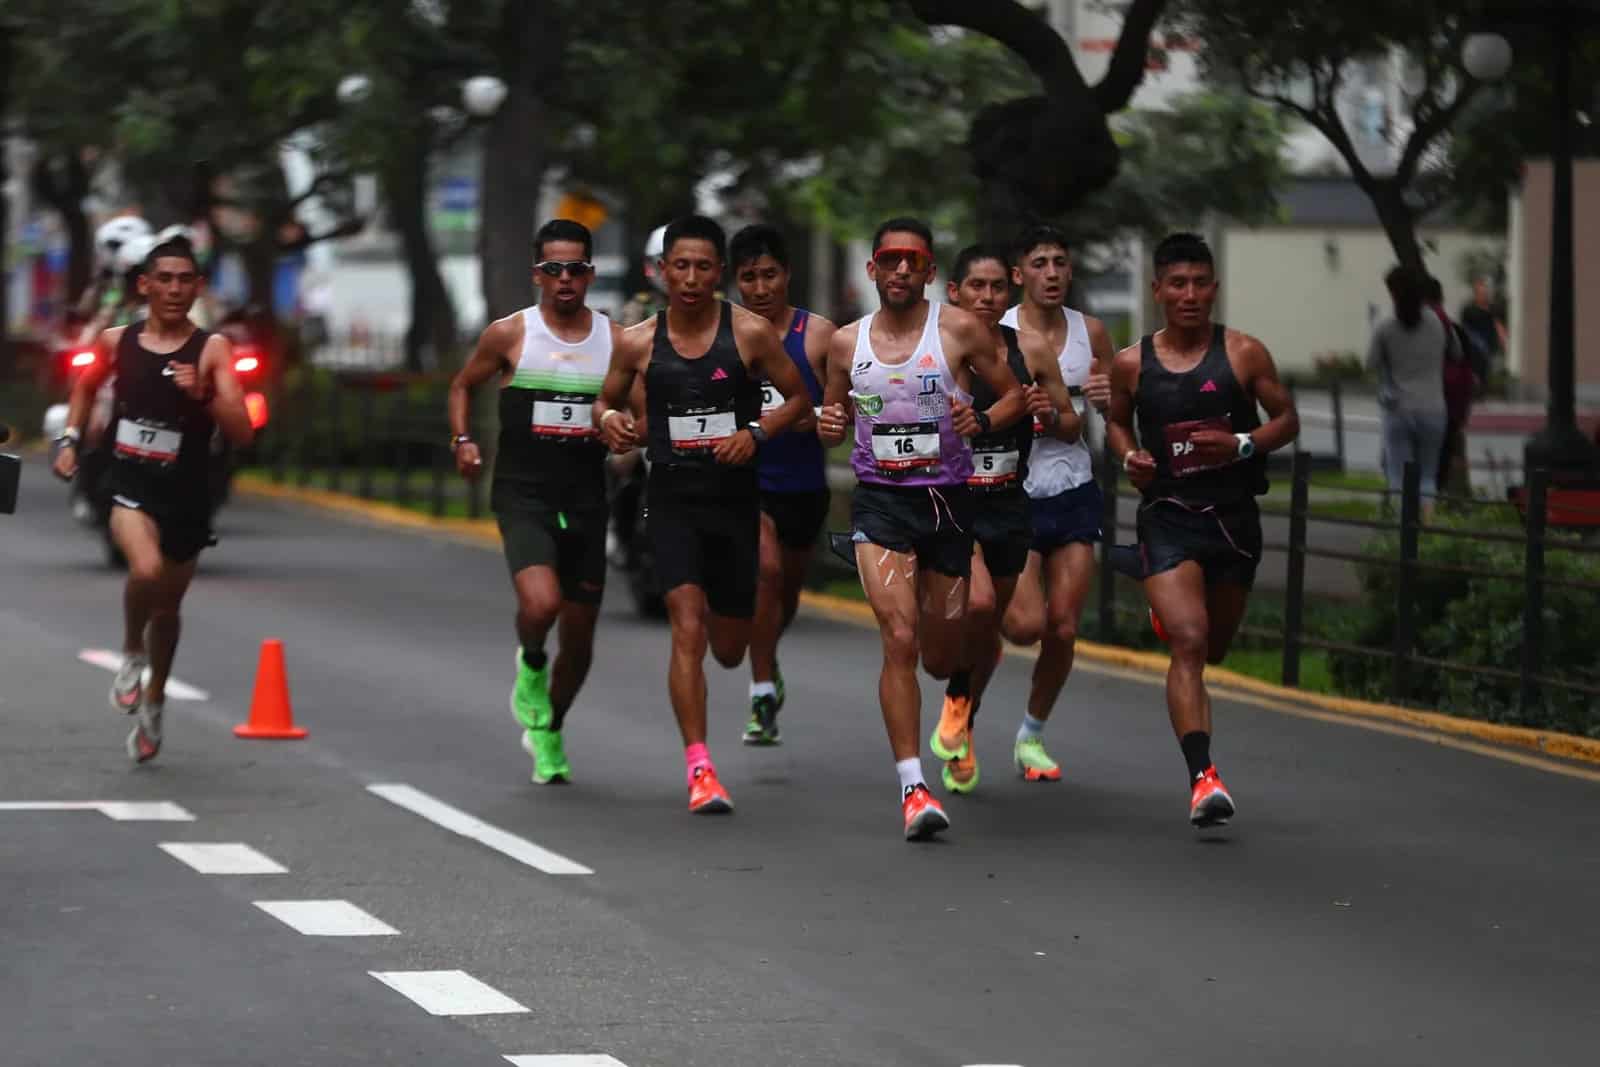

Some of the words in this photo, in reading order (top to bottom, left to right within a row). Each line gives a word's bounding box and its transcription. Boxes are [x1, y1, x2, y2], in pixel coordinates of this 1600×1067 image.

[562, 406, 572, 421] 9
[697, 418, 706, 433] 7
[139, 429, 156, 444] 17
[894, 438, 914, 455] 16
[983, 456, 993, 470] 5
